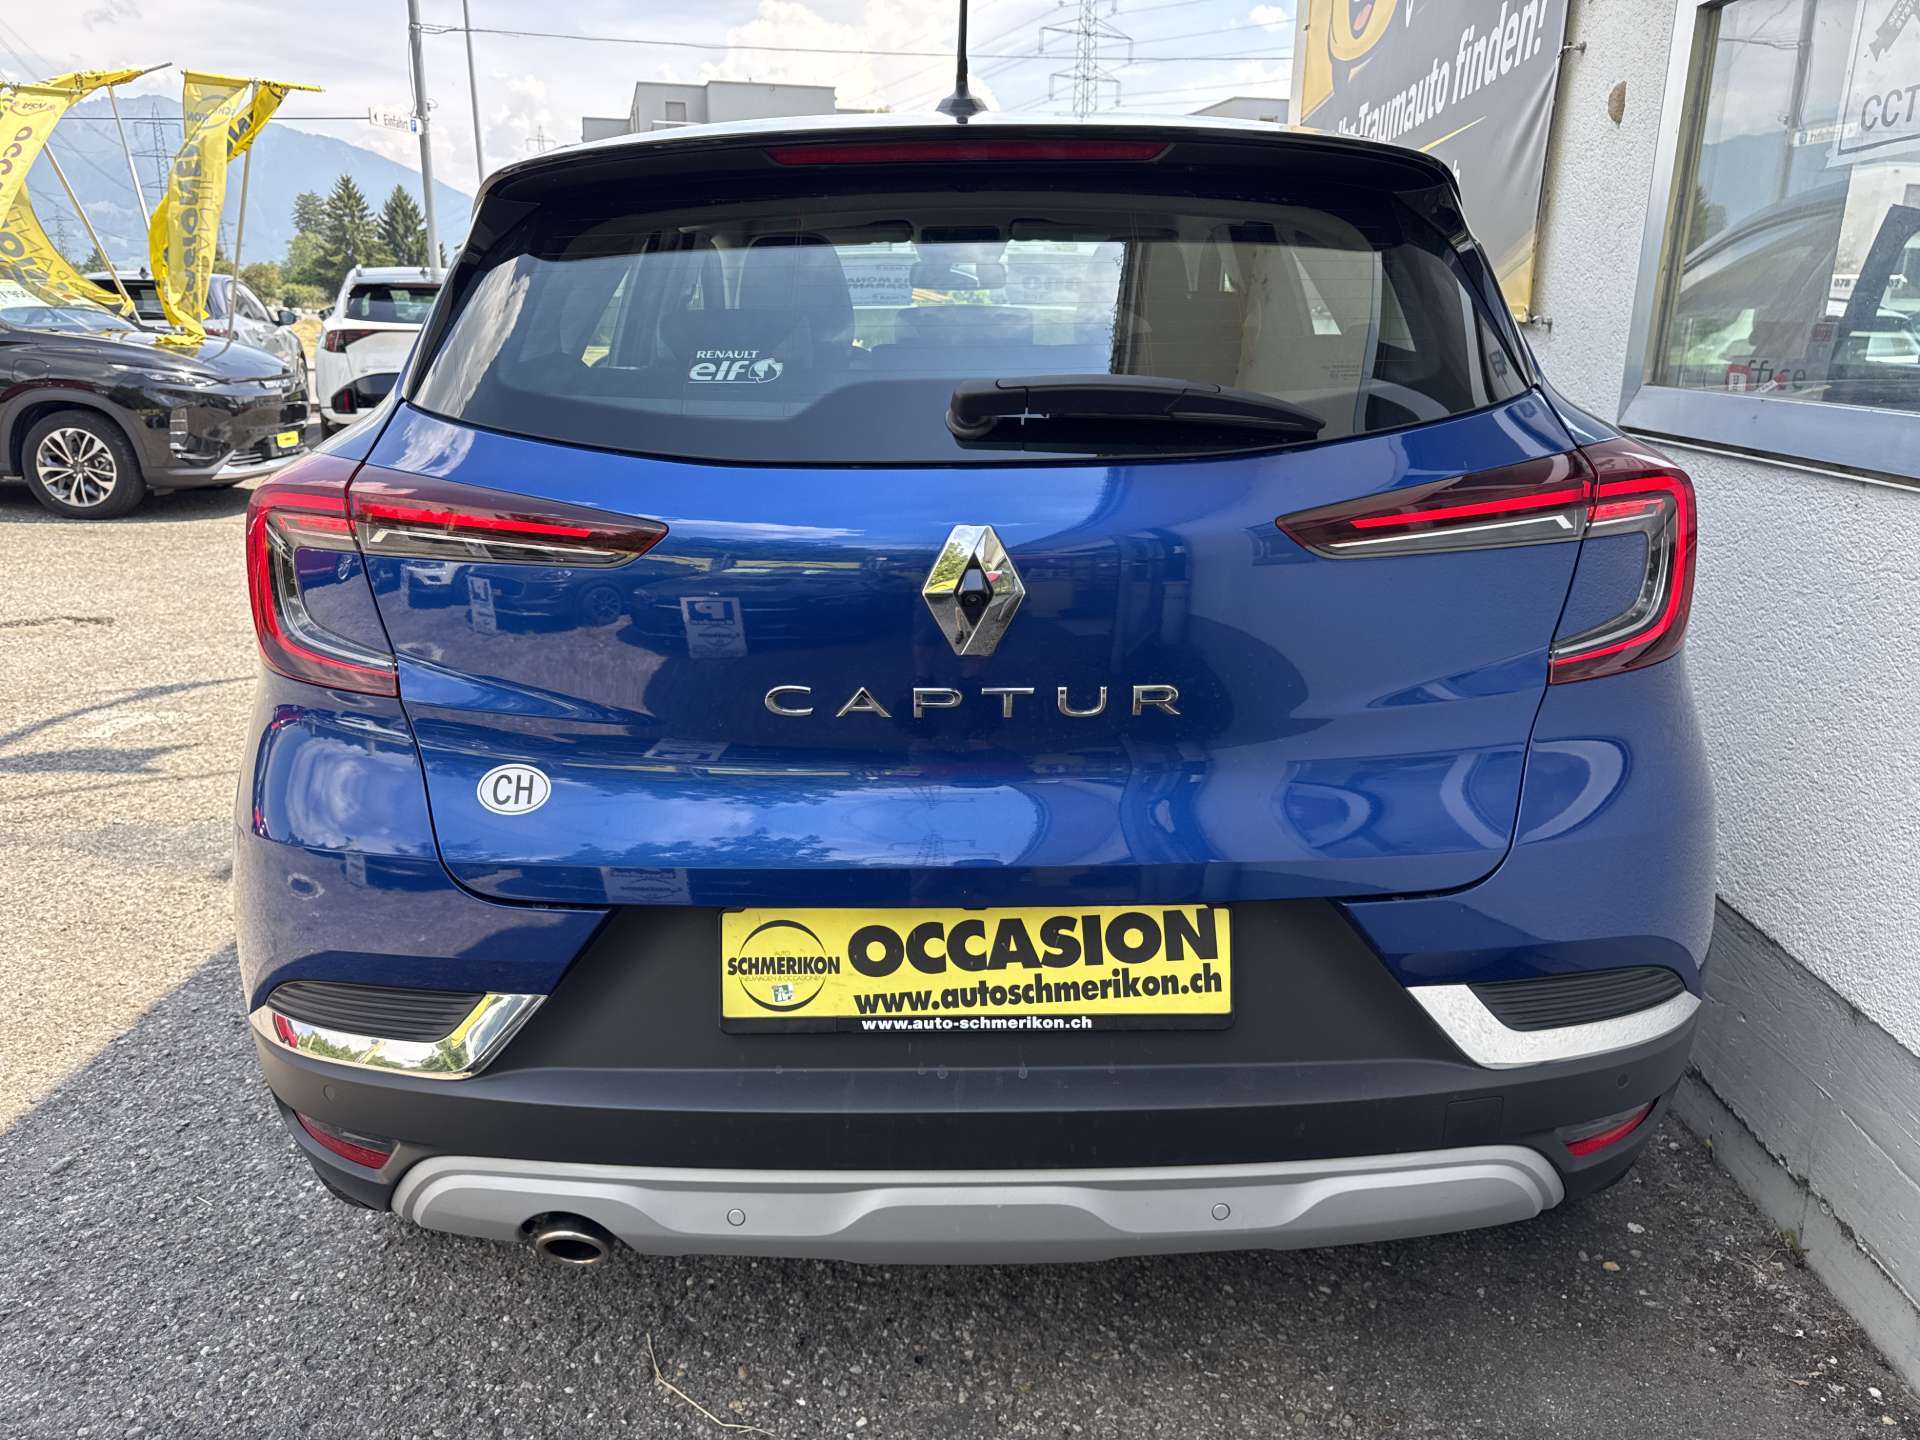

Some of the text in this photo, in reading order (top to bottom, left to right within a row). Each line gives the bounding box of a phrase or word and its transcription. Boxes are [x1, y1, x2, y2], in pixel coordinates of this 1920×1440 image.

[1359, 57, 1450, 142] Traumauto
[1452, 0, 1547, 104] finden!
[696, 350, 760, 359] RENAULT
[689, 360, 750, 381] elf
[765, 684, 1181, 719] CAPTUR
[492, 774, 534, 805] CH
[848, 908, 1219, 978] OCCASION
[728, 956, 840, 976] SCHMERIKON
[853, 963, 1222, 1015] www.autoschmerikon.ch
[862, 1016, 1093, 1029] www.auto-schmerikon.ch
